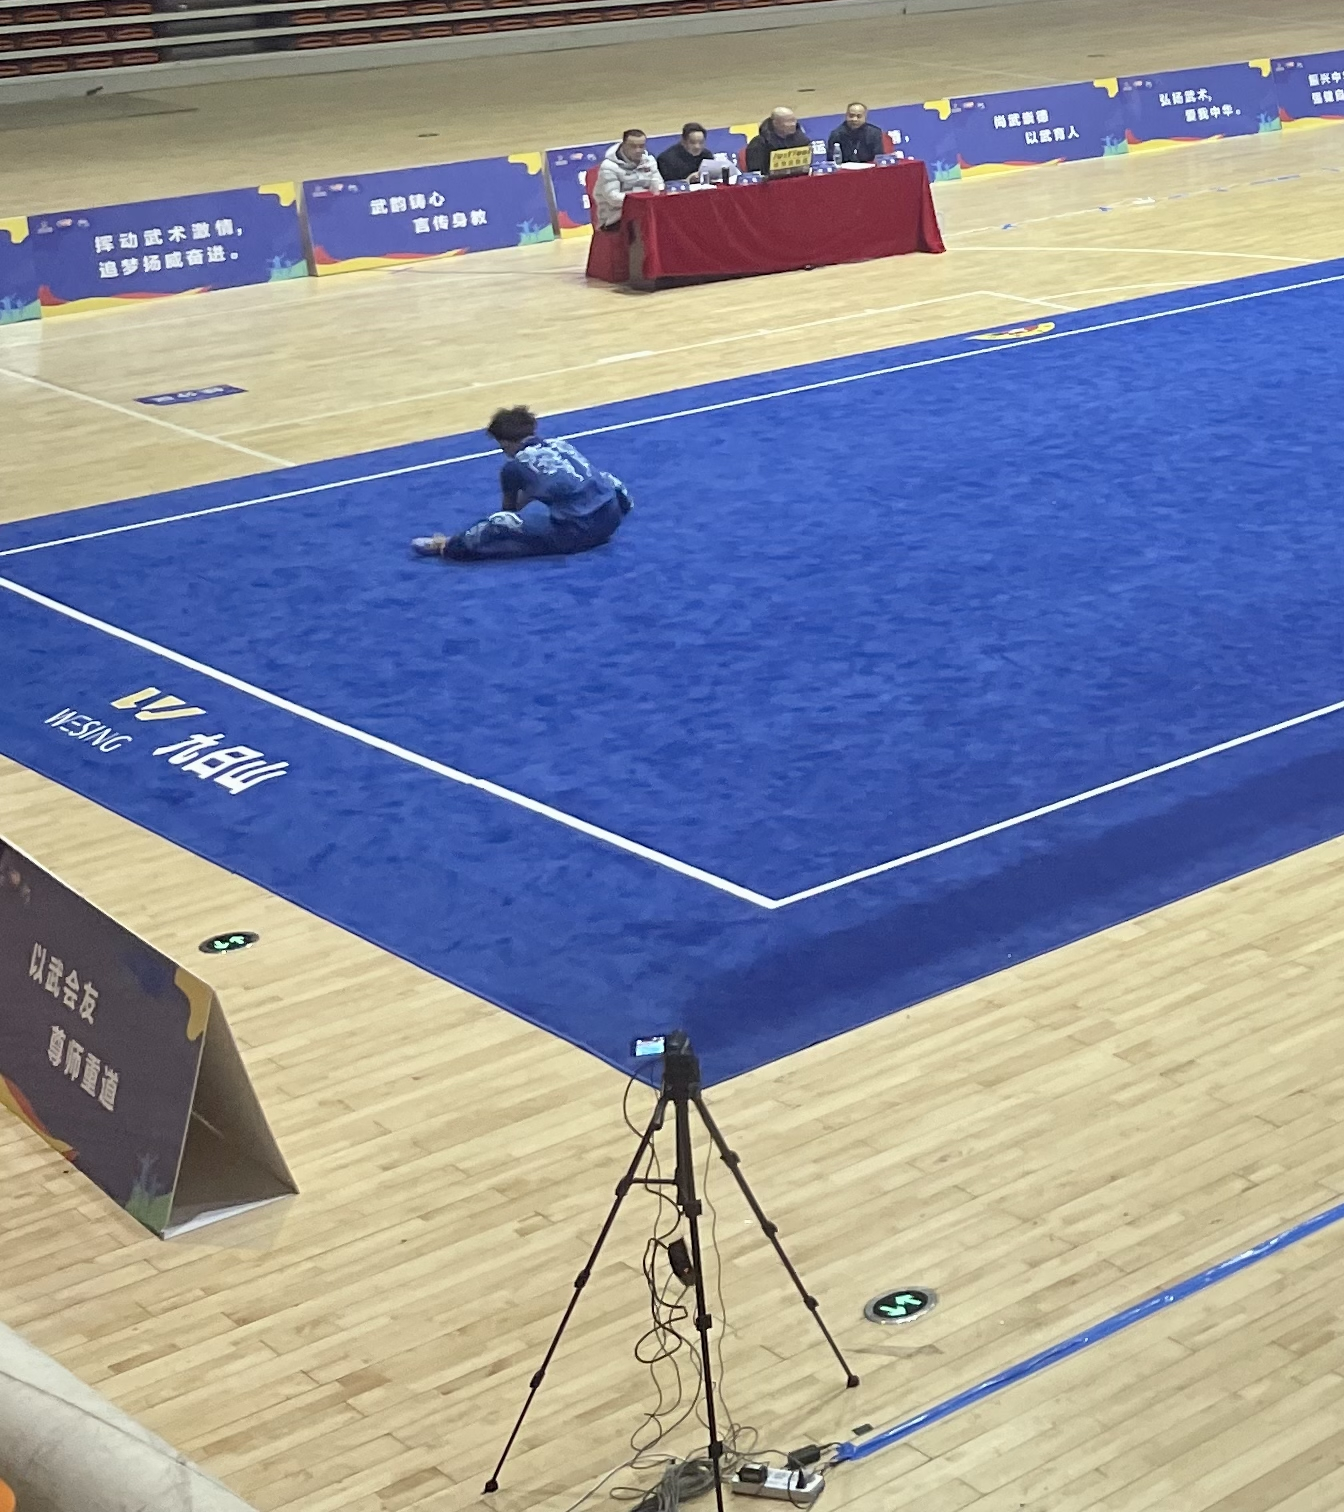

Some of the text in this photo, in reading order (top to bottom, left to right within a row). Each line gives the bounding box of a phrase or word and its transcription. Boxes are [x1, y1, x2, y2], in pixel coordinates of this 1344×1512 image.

[993, 109, 1049, 129] 尚武崇德
[1025, 125, 1079, 145] 以武育人
[28, 941, 99, 1025] 以武会友
[47, 1025, 120, 1112] 尊师重道
